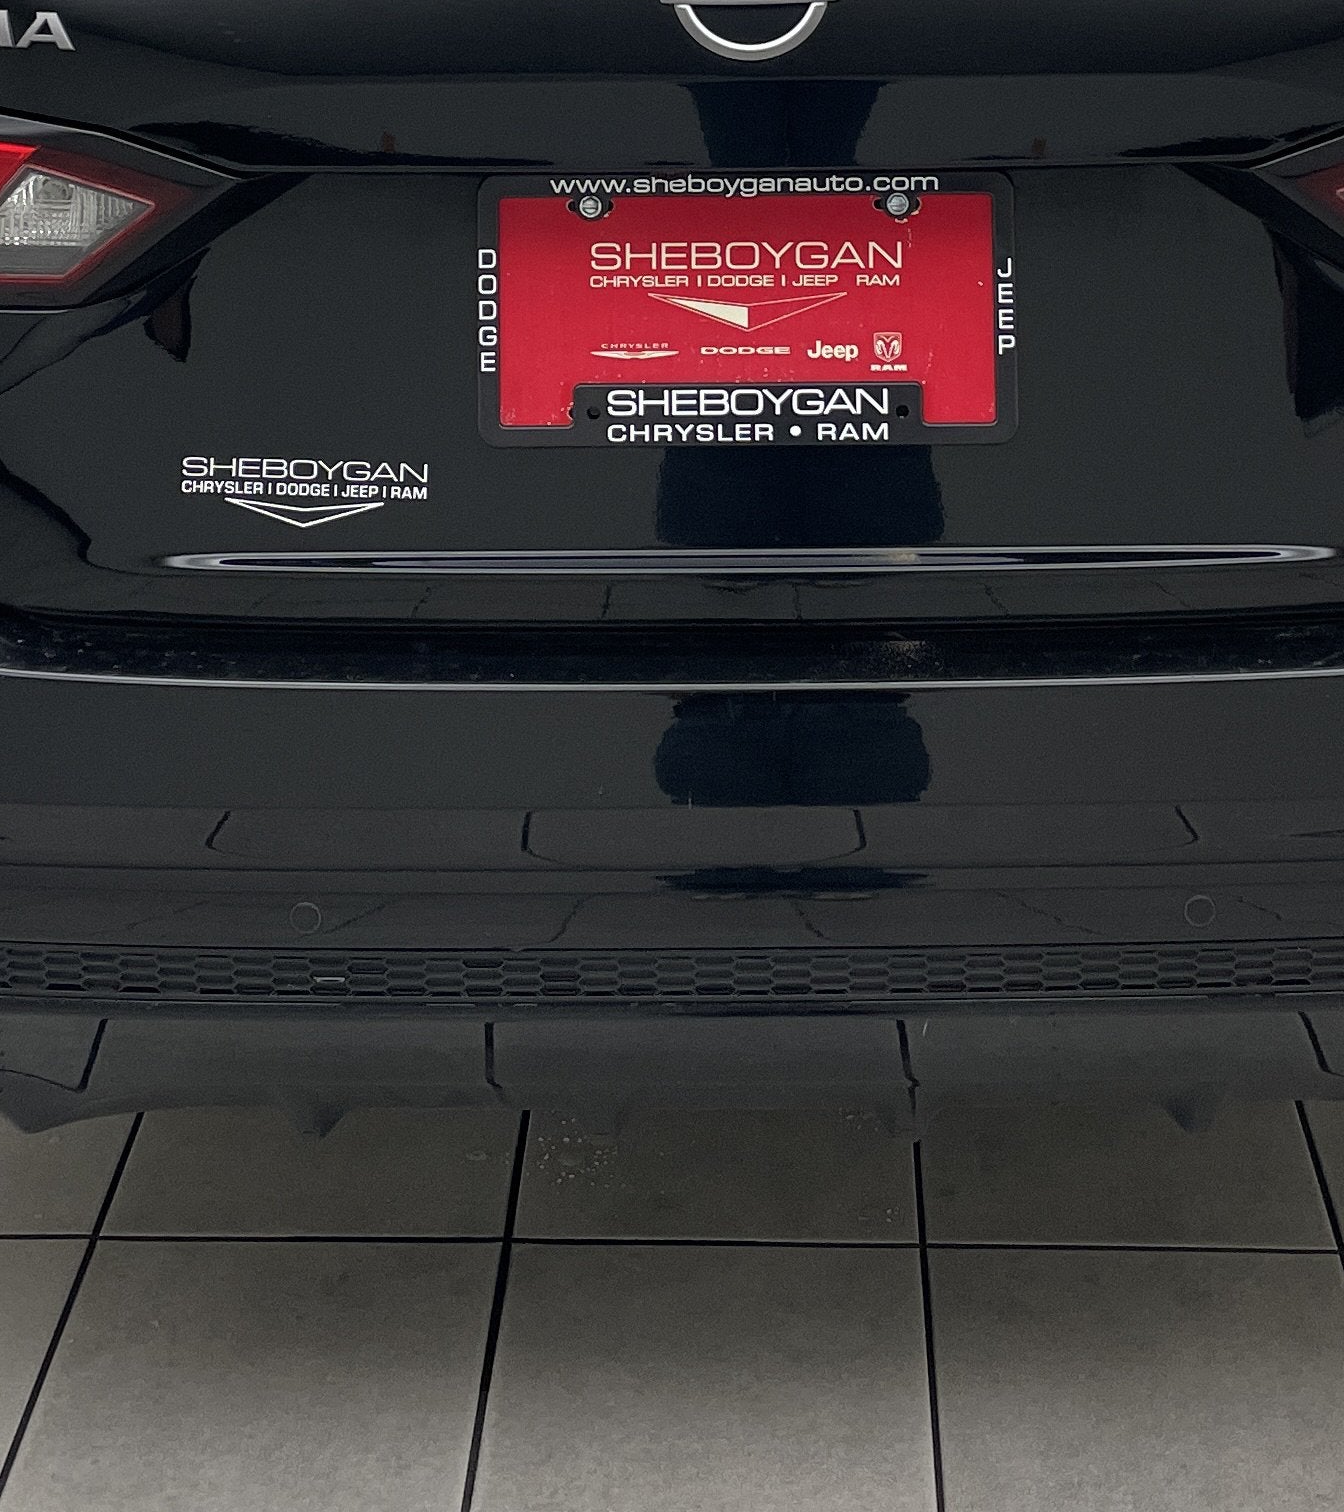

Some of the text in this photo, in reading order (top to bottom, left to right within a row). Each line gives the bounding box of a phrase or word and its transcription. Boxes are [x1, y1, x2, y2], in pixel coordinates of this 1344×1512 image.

[550, 174, 939, 197] www.sheboyganauto.com
[591, 242, 902, 270] SHEBOYGAN
[589, 274, 900, 288] CHRYSLER DODGE JEEP RAM
[478, 249, 497, 372] DODGE
[997, 258, 1015, 355] JEEP
[700, 346, 791, 355] DODGE
[807, 340, 858, 361] Jeep
[870, 363, 908, 372] RAM
[608, 388, 888, 416] SHEBOYGAN
[608, 423, 888, 442] CHRYSLER RAM
[182, 457, 428, 483] SHEBOYGAN
[182, 480, 427, 499] CHRYSLER DODGE JEEP RAM
